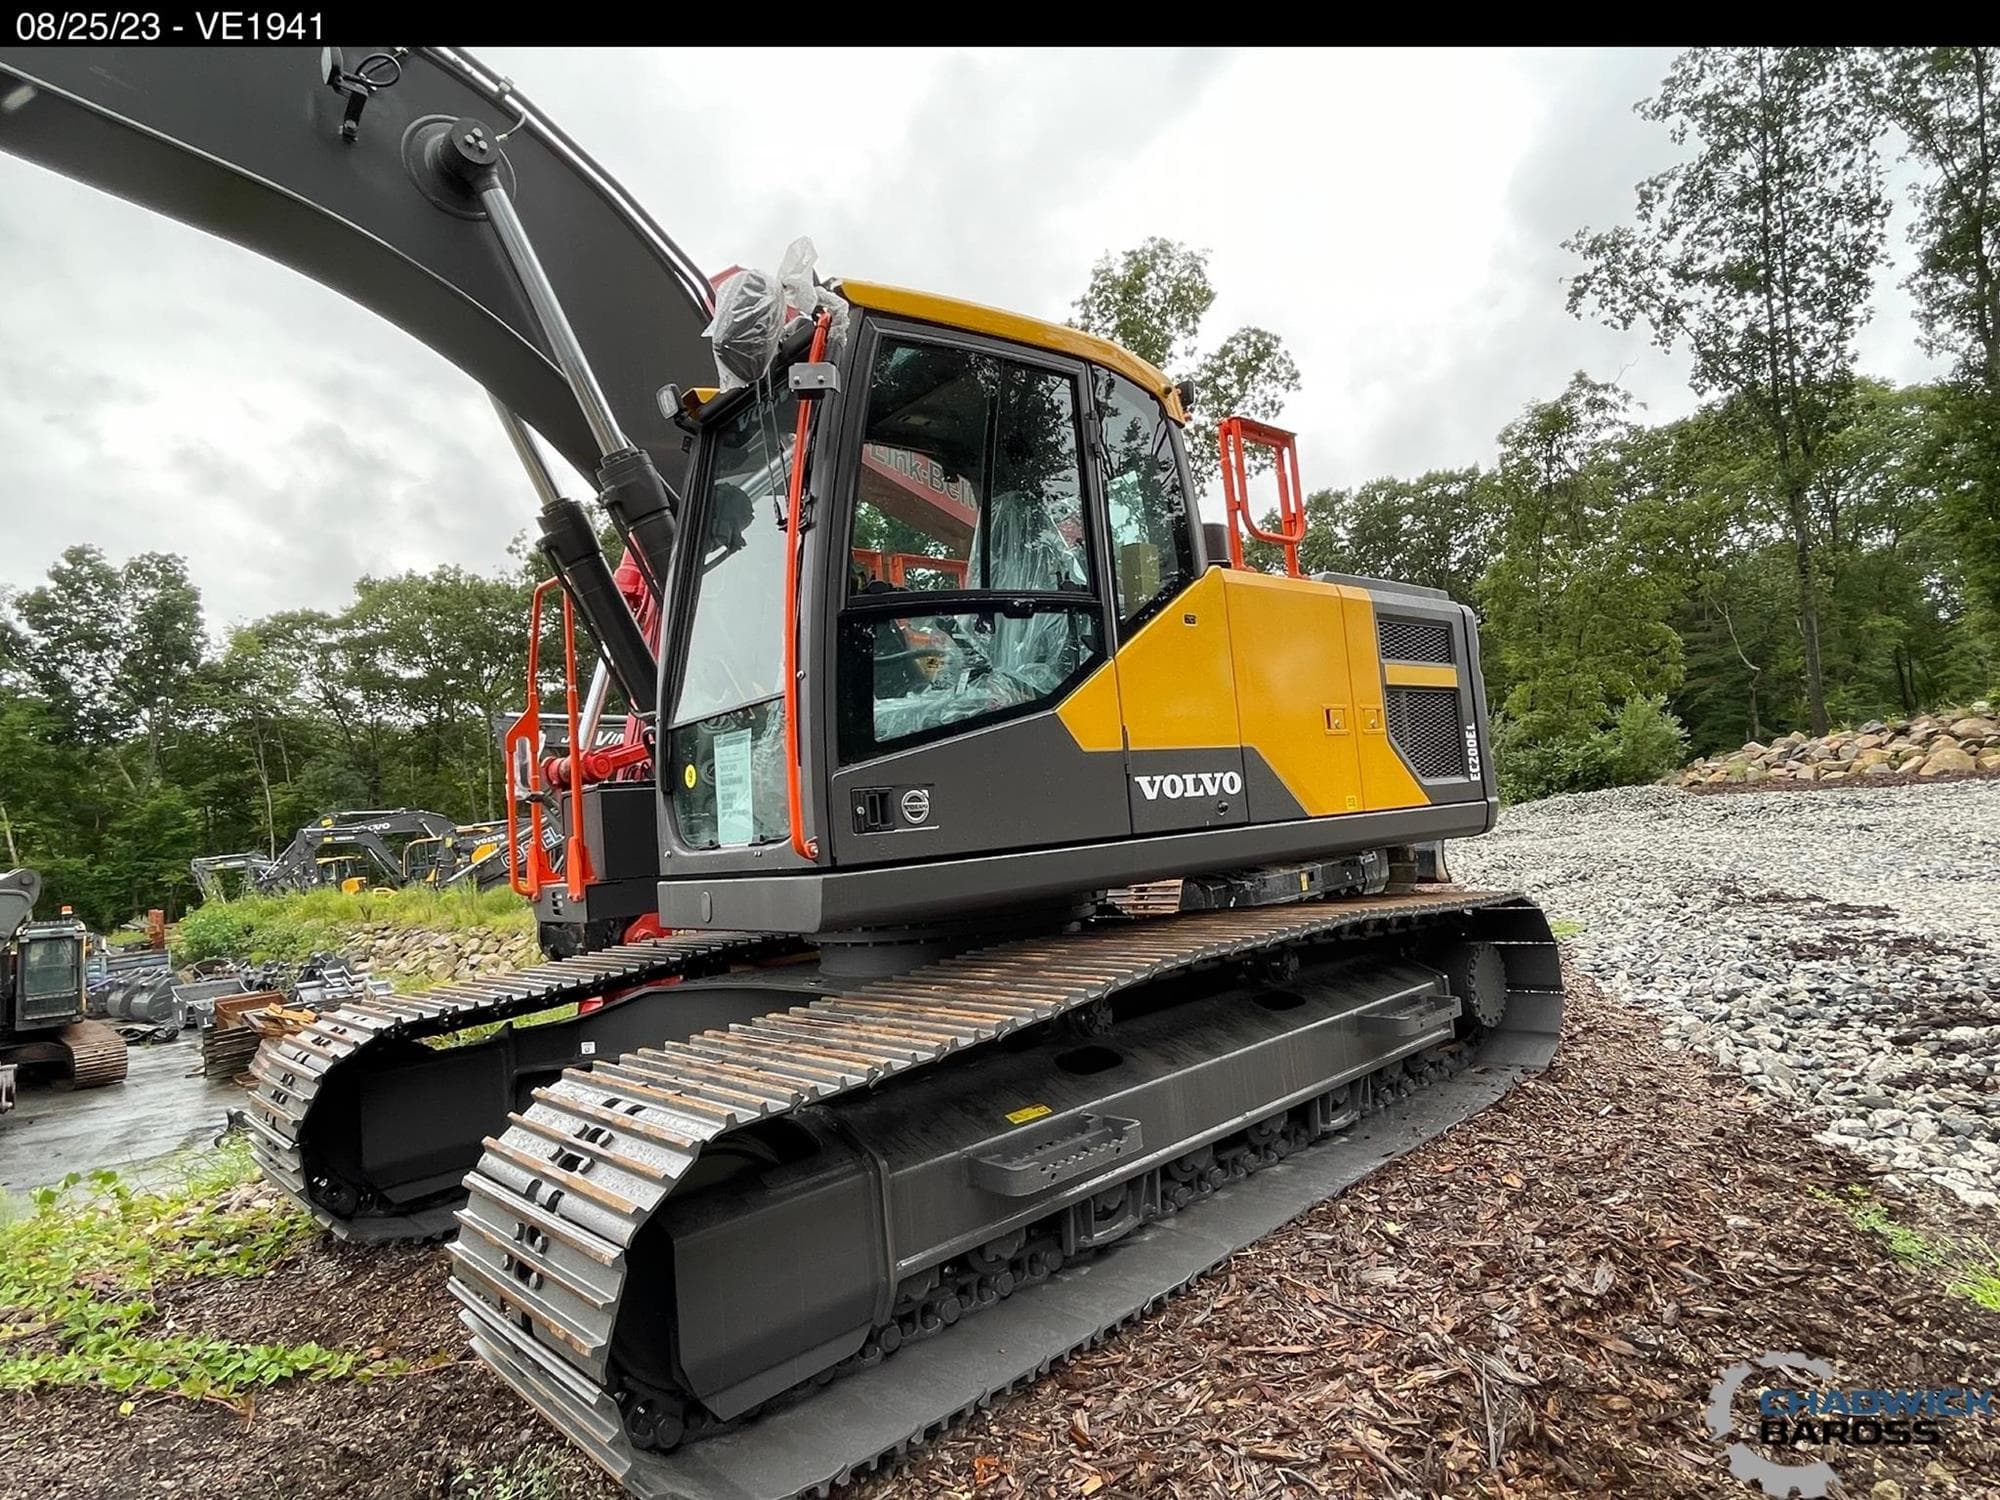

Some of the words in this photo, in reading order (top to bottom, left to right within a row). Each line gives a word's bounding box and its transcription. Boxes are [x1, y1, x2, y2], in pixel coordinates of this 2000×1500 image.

[1465, 722, 1480, 781] EC200EL
[1134, 771, 1242, 800] VOLVO
[474, 833, 506, 846] VOLVO
